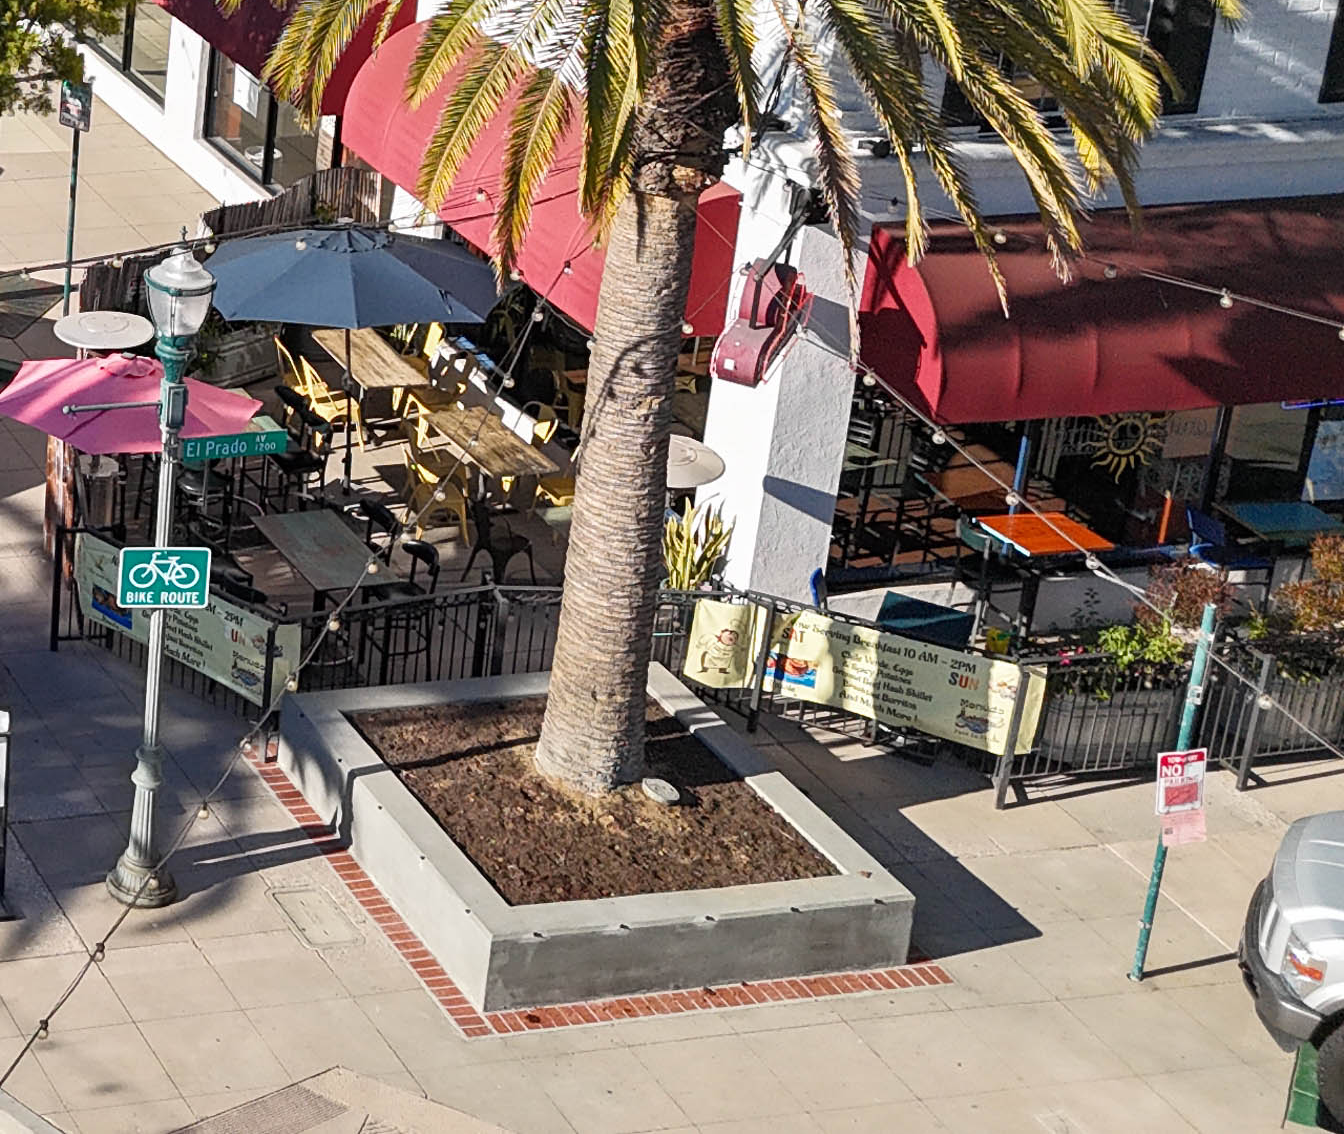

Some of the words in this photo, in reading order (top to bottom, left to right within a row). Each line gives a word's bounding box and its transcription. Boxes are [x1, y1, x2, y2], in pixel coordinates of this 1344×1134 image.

[256, 434, 268, 443] AV
[186, 442, 201, 458] El
[205, 439, 248, 457] Prado
[255, 442, 276, 452] 1200
[126, 591, 154, 603] BIKE
[160, 591, 200, 604] ROUTE
[782, 627, 805, 643] SAT
[903, 646, 917, 660] 10
[918, 650, 939, 665] AM
[950, 658, 977, 675] 2PM
[948, 671, 981, 691] SUN
[885, 706, 913, 723] More
[1162, 765, 1182, 777] NO
